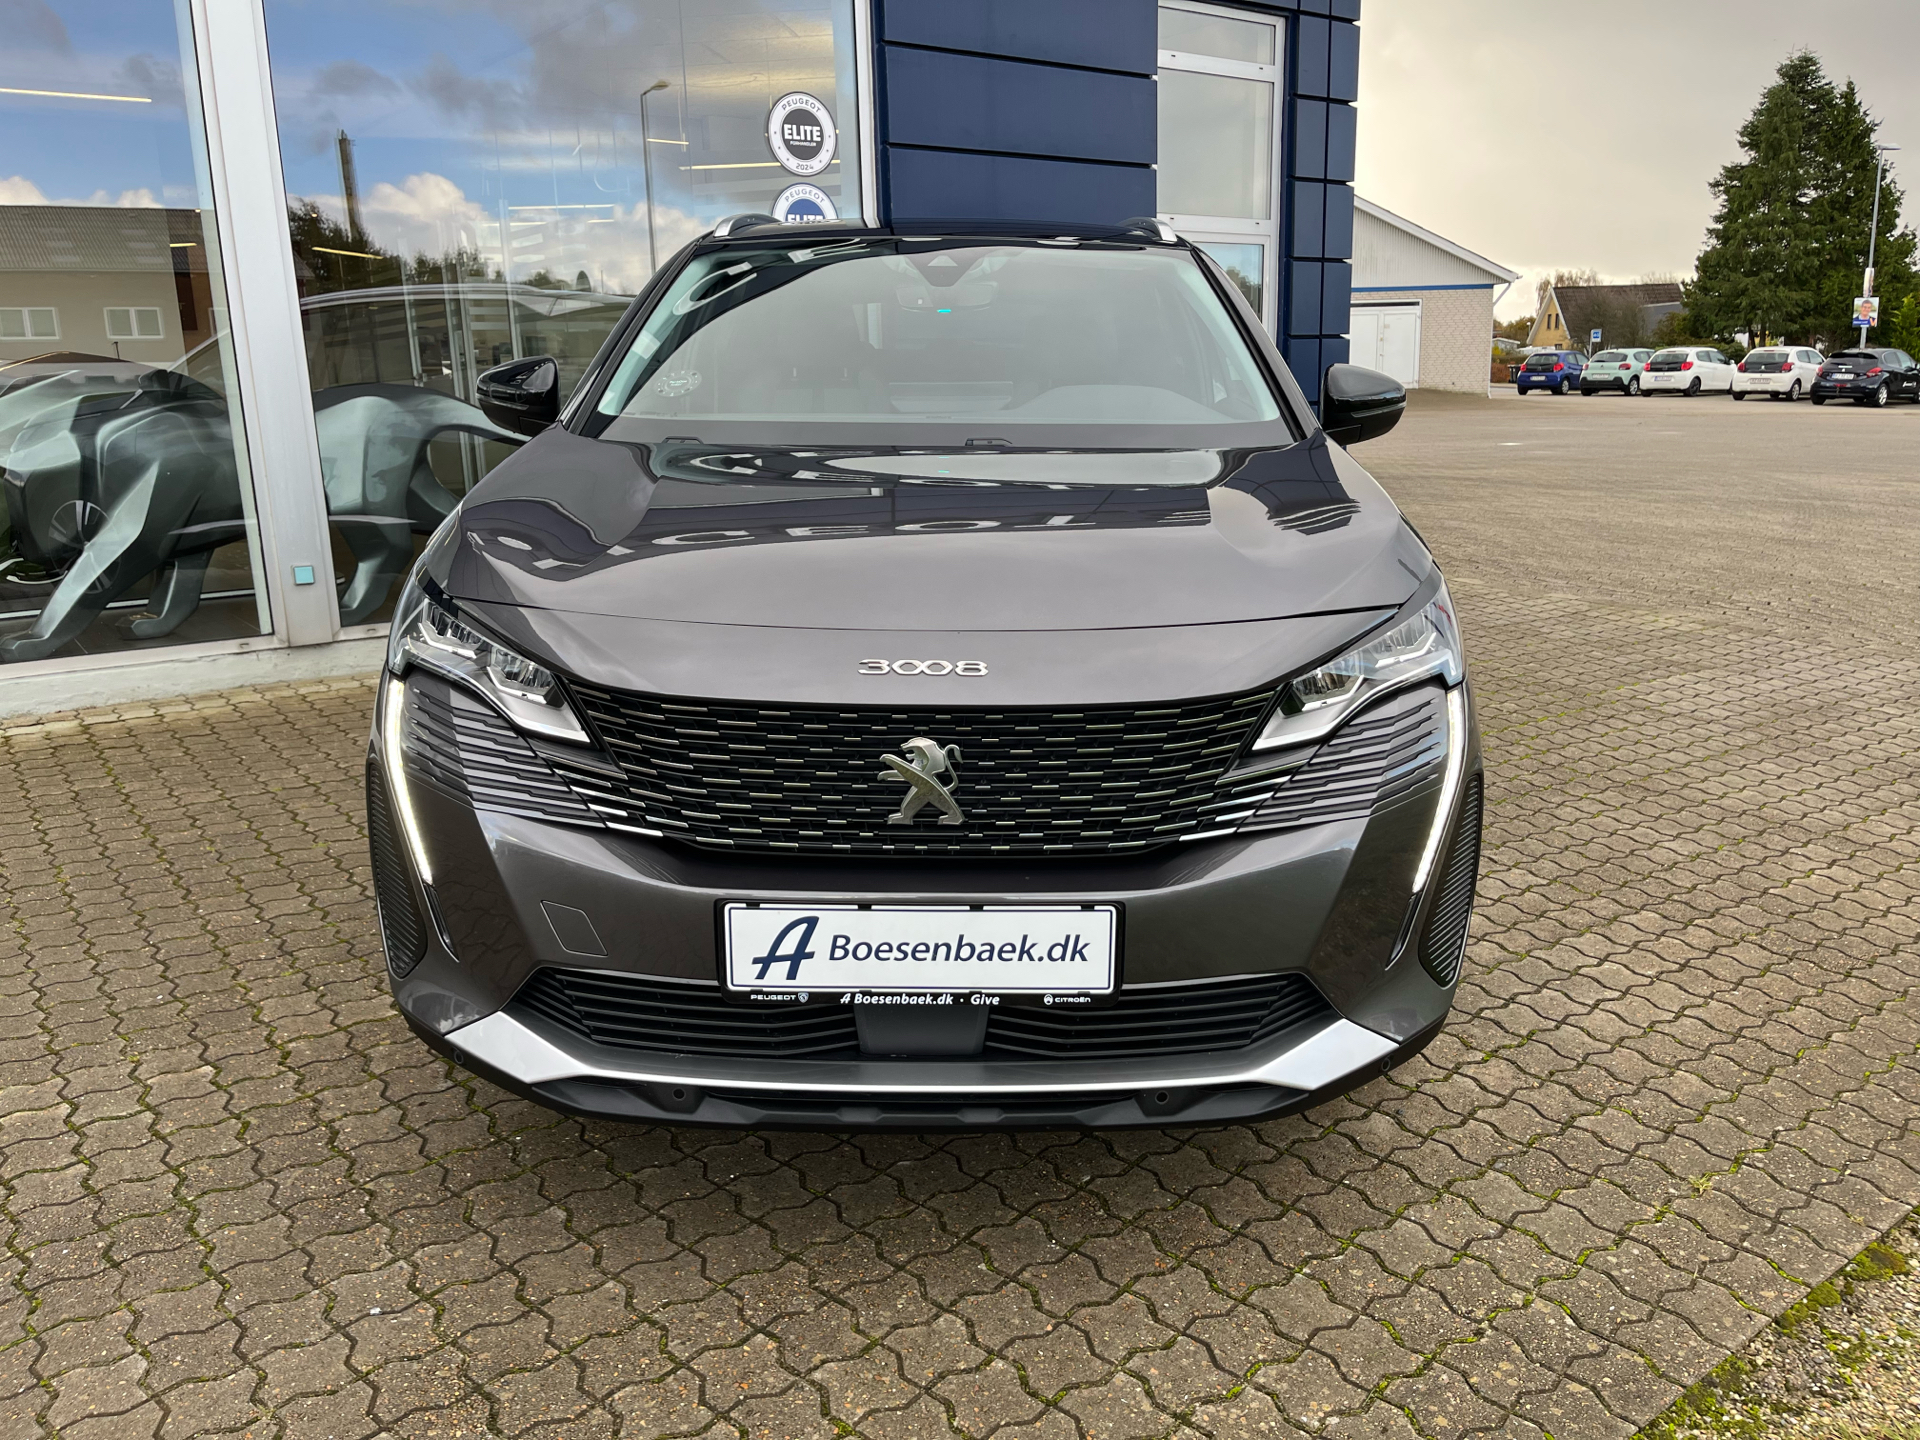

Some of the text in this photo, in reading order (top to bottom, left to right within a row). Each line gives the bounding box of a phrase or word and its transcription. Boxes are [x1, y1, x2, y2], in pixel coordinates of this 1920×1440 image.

[782, 98, 821, 113] PEUGEOT
[784, 124, 821, 141] ELITE
[795, 163, 814, 171] 2024
[785, 189, 825, 203] PEUGEOT
[857, 658, 989, 677] 3008
[828, 934, 1091, 963] Boesenbaek.dk
[854, 993, 953, 1005] Boesenbaek.dk
[970, 994, 1000, 1005] Give
